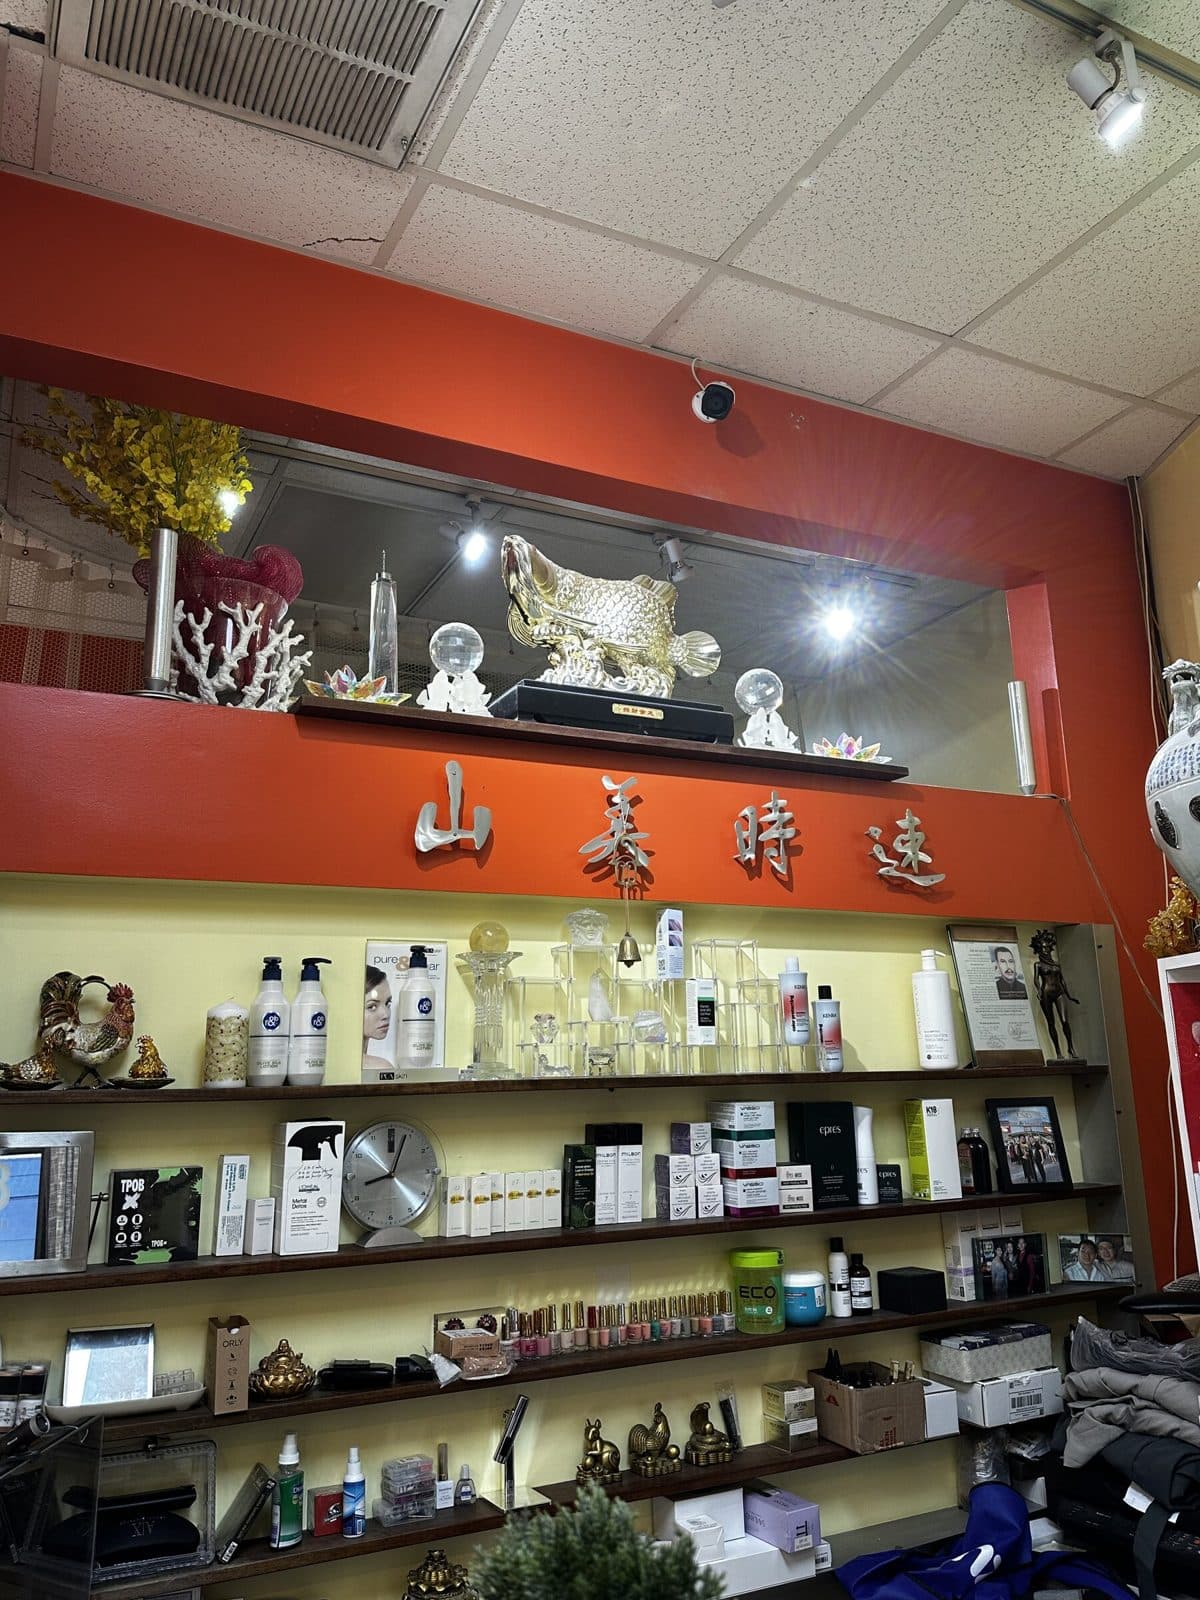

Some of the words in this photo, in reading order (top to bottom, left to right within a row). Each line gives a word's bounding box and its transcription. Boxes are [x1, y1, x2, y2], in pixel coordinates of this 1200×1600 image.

[373, 956, 398, 965] pure
[926, 1106, 938, 1114] K18
[820, 1126, 842, 1136] epres
[879, 1171, 896, 1179] epres
[120, 1179, 145, 1193] TPOB
[740, 1286, 776, 1299] ECO
[222, 1339, 244, 1348] ORLY
